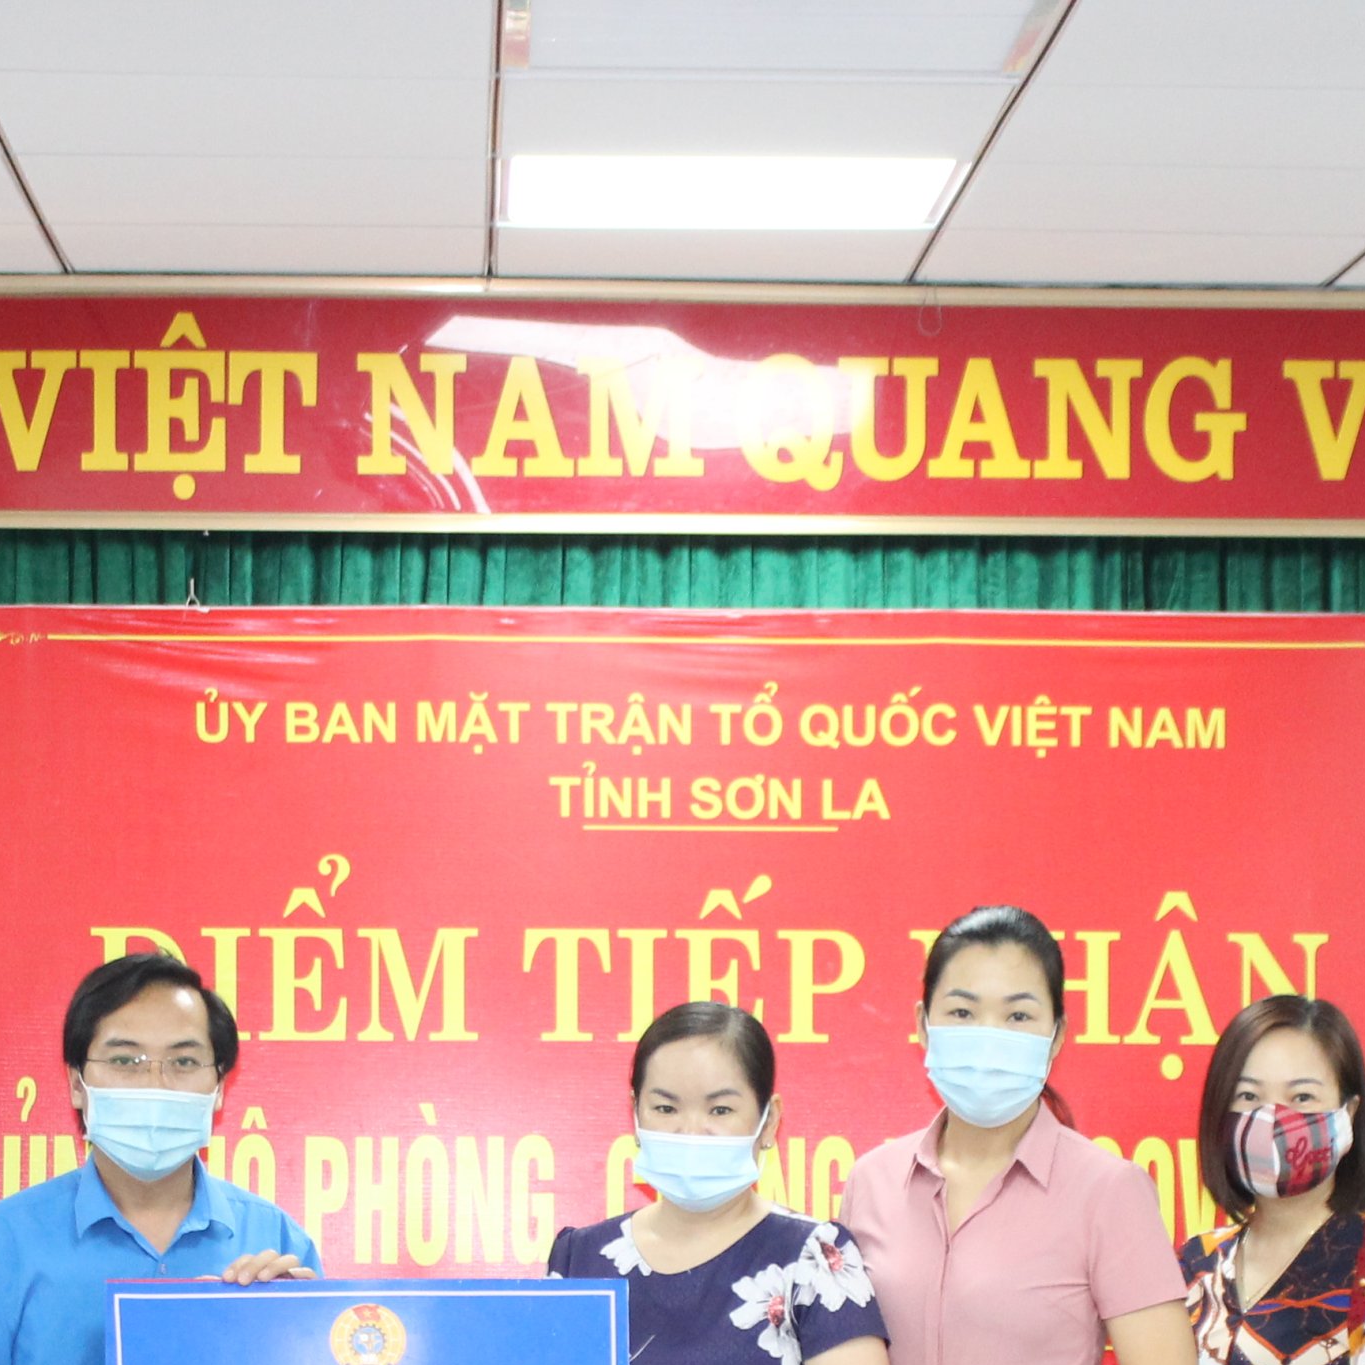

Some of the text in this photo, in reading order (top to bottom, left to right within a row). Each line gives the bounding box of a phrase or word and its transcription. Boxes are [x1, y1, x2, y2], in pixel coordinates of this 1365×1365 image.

[356, 354, 705, 478] NAM
[737, 353, 1247, 491] QUANG
[195, 680, 1226, 759] ỦY BAN MẶT TRẬN TỔ QUỐC VIỆT NAM
[548, 760, 892, 821] TỈNH SƠN LA
[522, 874, 866, 1044] TIẾP
[908, 890, 1329, 1081] HẬN
